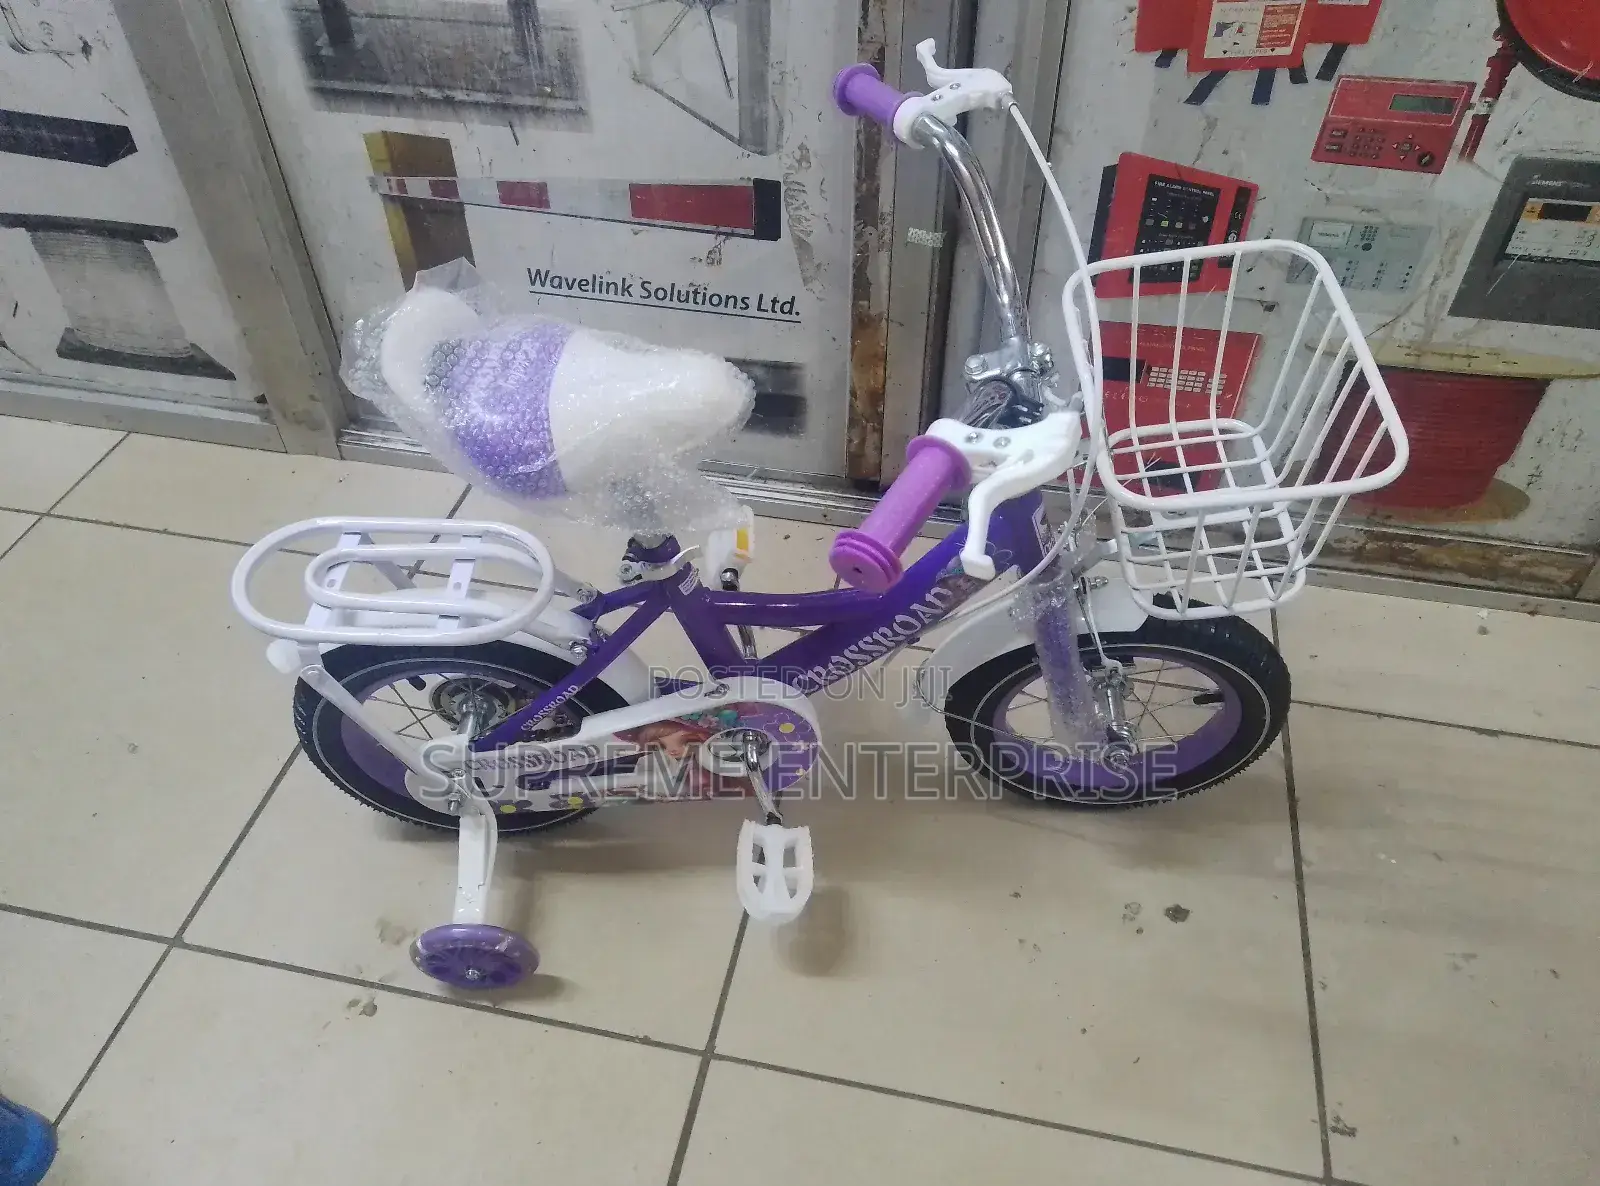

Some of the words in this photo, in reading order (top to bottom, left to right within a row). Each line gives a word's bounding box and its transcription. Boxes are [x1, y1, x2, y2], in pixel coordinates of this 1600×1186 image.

[527, 268, 633, 298] Wavelink
[639, 280, 750, 311] Solutions
[756, 293, 801, 317] Ltd.
[791, 586, 954, 695] CROSSROAD
[520, 684, 579, 732] CROSSROAD
[464, 744, 601, 772] CROSSROAD
